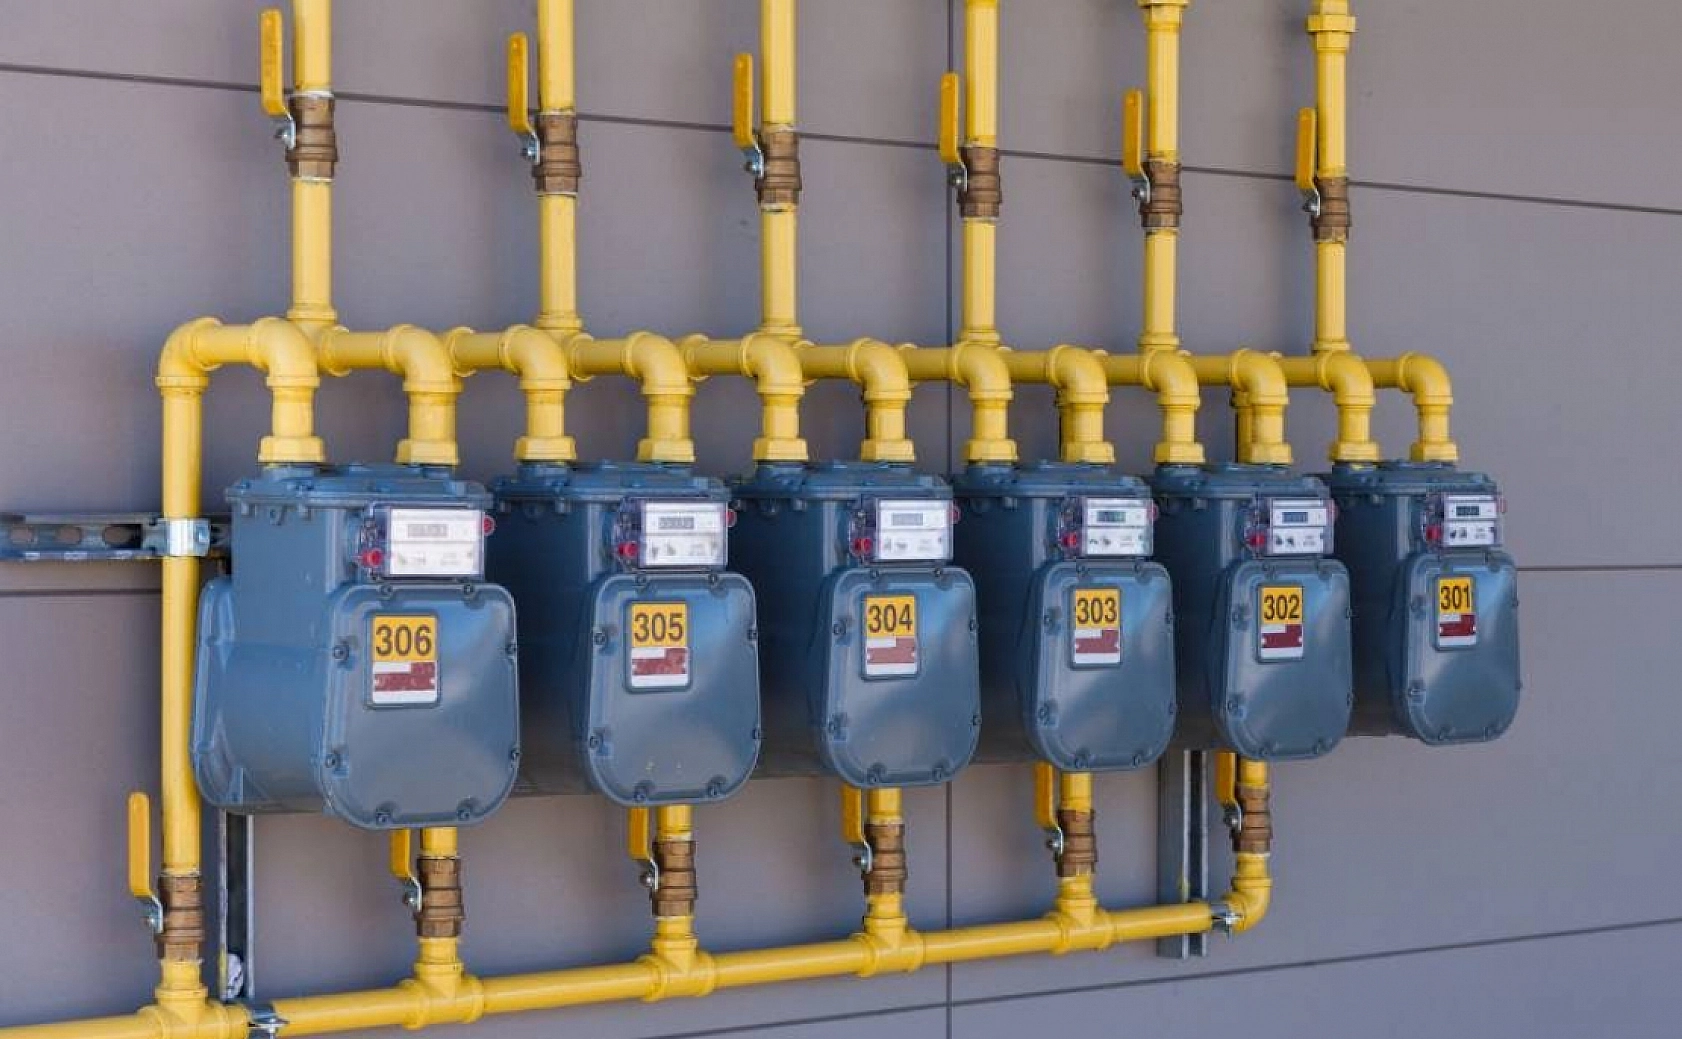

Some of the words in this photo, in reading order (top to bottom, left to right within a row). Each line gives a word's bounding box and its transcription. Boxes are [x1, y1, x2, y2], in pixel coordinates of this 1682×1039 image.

[1076, 597, 1117, 624] 303
[1264, 594, 1300, 620] 302
[1440, 585, 1471, 610] 301
[634, 612, 684, 641] 305
[868, 604, 913, 633] 304
[376, 625, 433, 655] 306
